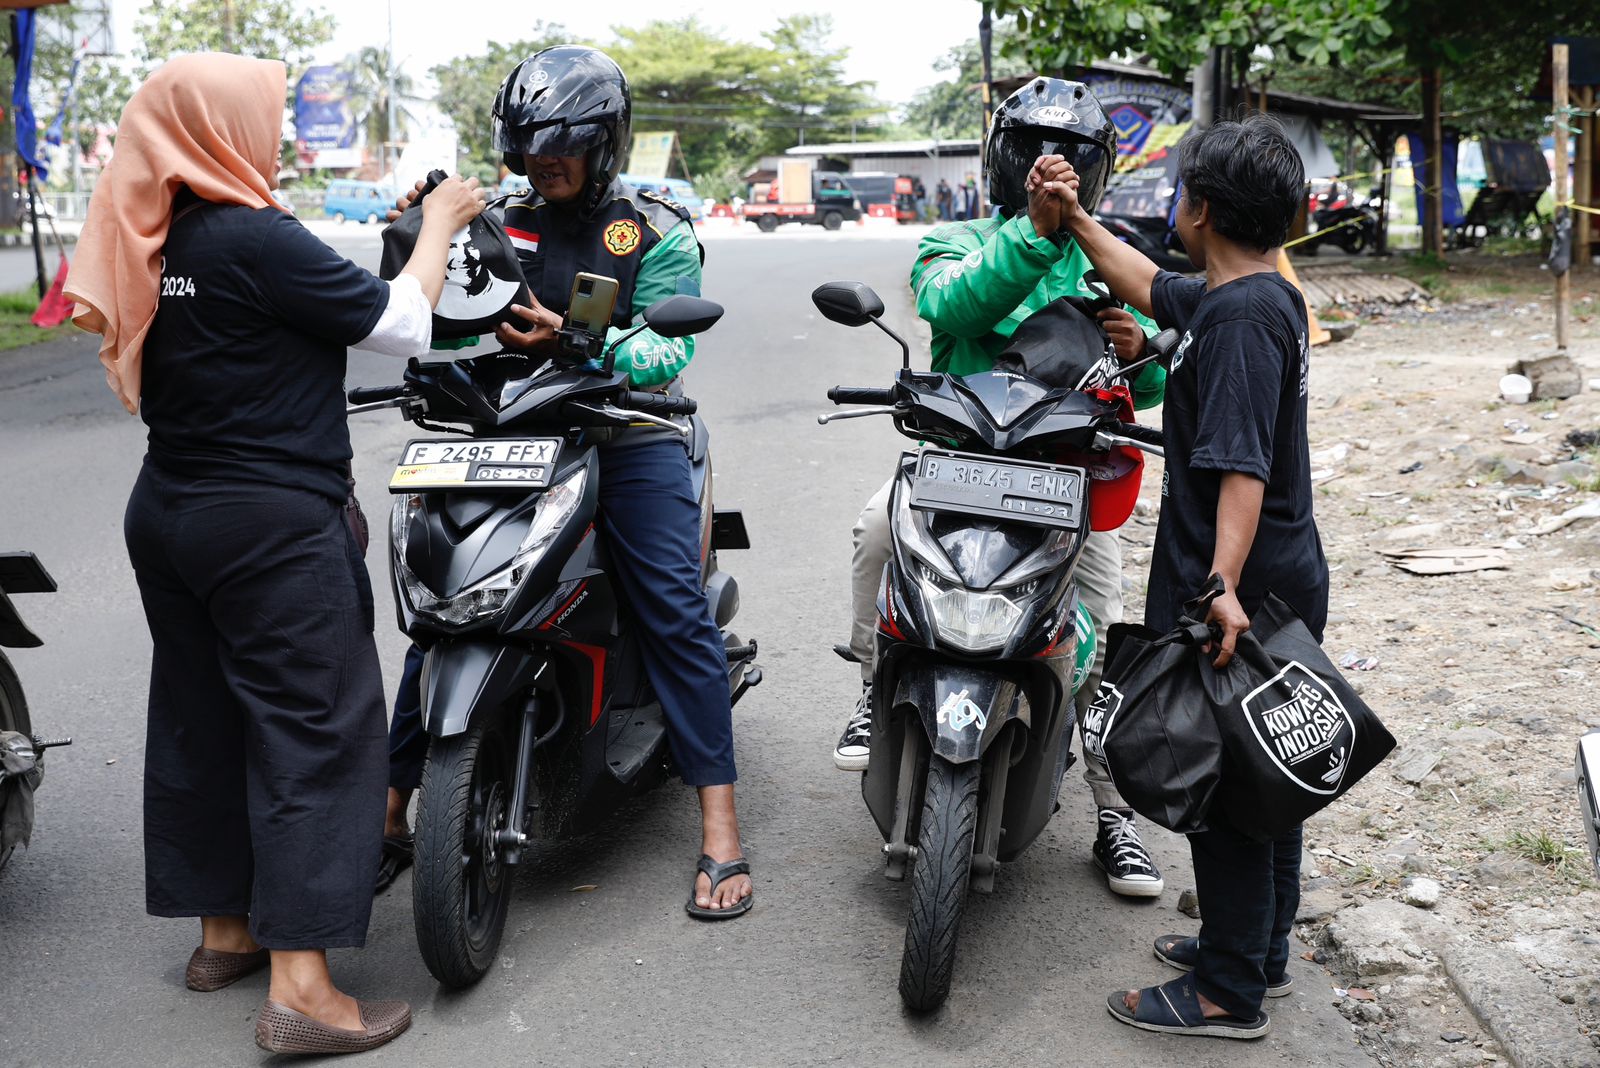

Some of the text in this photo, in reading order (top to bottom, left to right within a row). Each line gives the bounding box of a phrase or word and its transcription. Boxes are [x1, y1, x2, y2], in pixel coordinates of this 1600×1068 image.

[161, 276, 196, 297] 2024
[992, 372, 1026, 381] HONDA
[412, 445, 550, 464] F 2495 FFX
[925, 459, 940, 480] B
[953, 464, 1014, 489] 3645
[1027, 474, 1074, 498] ENK
[557, 590, 589, 625] HONDA
